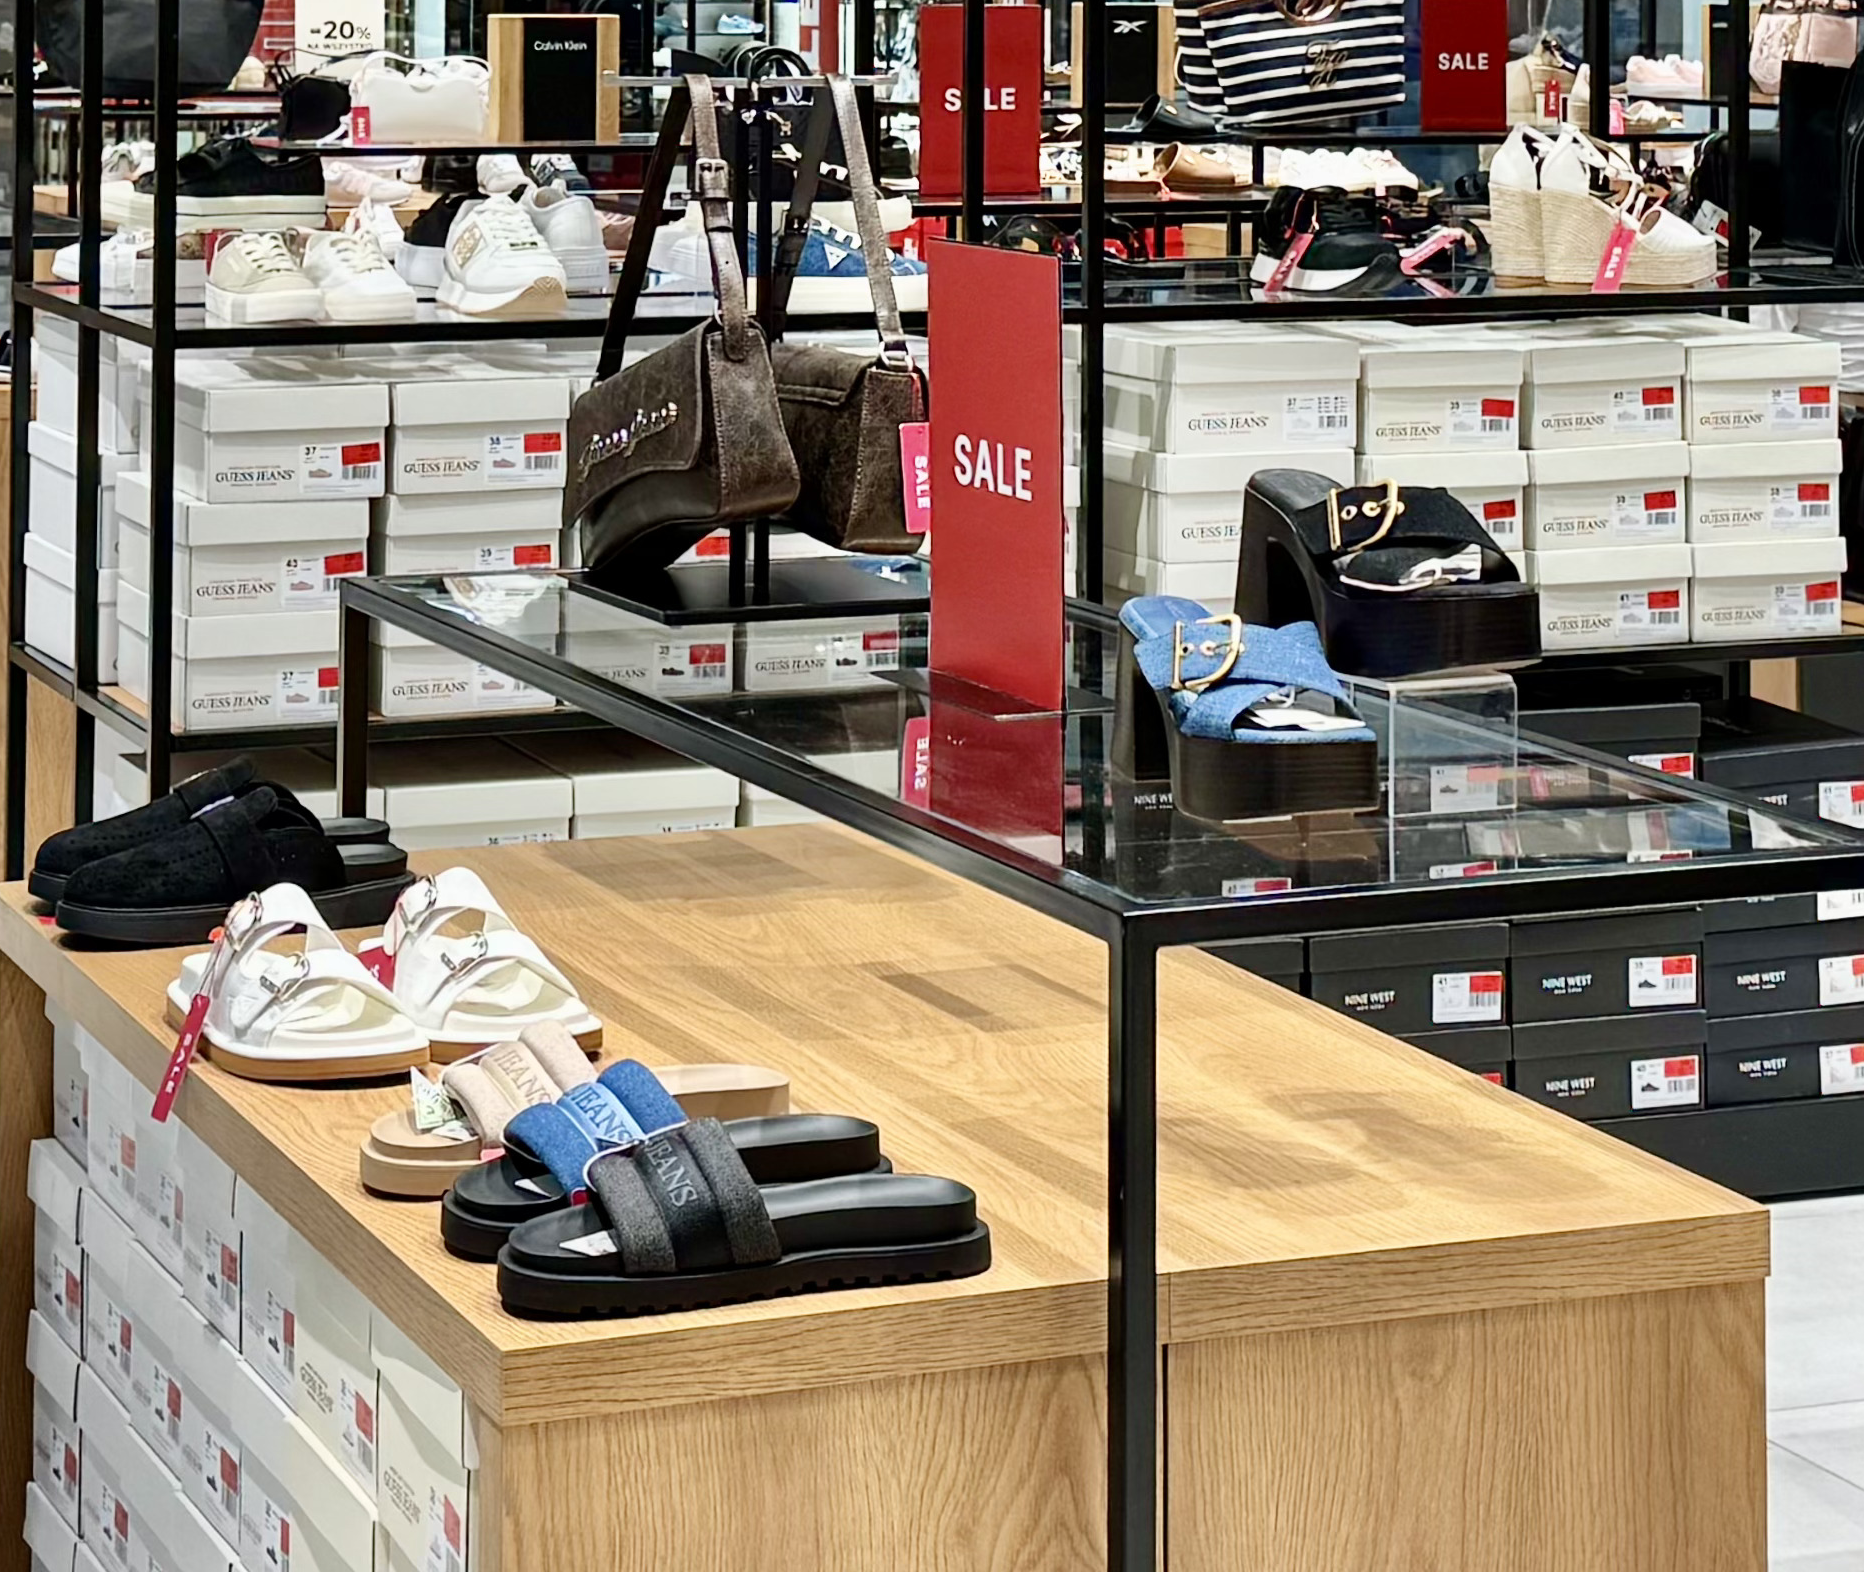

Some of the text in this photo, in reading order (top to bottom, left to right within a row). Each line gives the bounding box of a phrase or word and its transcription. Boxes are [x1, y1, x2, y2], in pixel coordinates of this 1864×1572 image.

[534, 39, 563, 52] Calvin
[1438, 52, 1490, 70] SALE
[944, 87, 1016, 111] SLE
[1604, 246, 1622, 278] SALE
[1188, 415, 1269, 430] GUESS JEANS
[1541, 417, 1573, 429] GUESS
[1700, 415, 1731, 427] GUESS
[1375, 426, 1408, 438] GUESS
[404, 461, 441, 474] GUESS
[953, 433, 1034, 502] SALE
[215, 471, 255, 483] GUESS
[914, 455, 932, 509] SALE
[1699, 512, 1731, 525] GUESS
[1181, 525, 1223, 540] GUESS
[1543, 521, 1575, 534] GUESS
[196, 582, 277, 597] GUESS JEANS
[1547, 619, 1580, 632] GUESS
[392, 684, 430, 697] GUESS
[192, 695, 272, 710] GUESS JEANS
[1542, 974, 1593, 989] NINE WEST
[1736, 971, 1787, 986] NINE WEST
[1345, 991, 1396, 1005] NINE WEST
[165, 1033, 193, 1094] SALE
[1739, 1058, 1788, 1073] NINE WEST
[1546, 1077, 1596, 1092] NINE WEST
[570, 1085, 633, 1145] JEANS
[644, 1134, 698, 1208] JEANS
